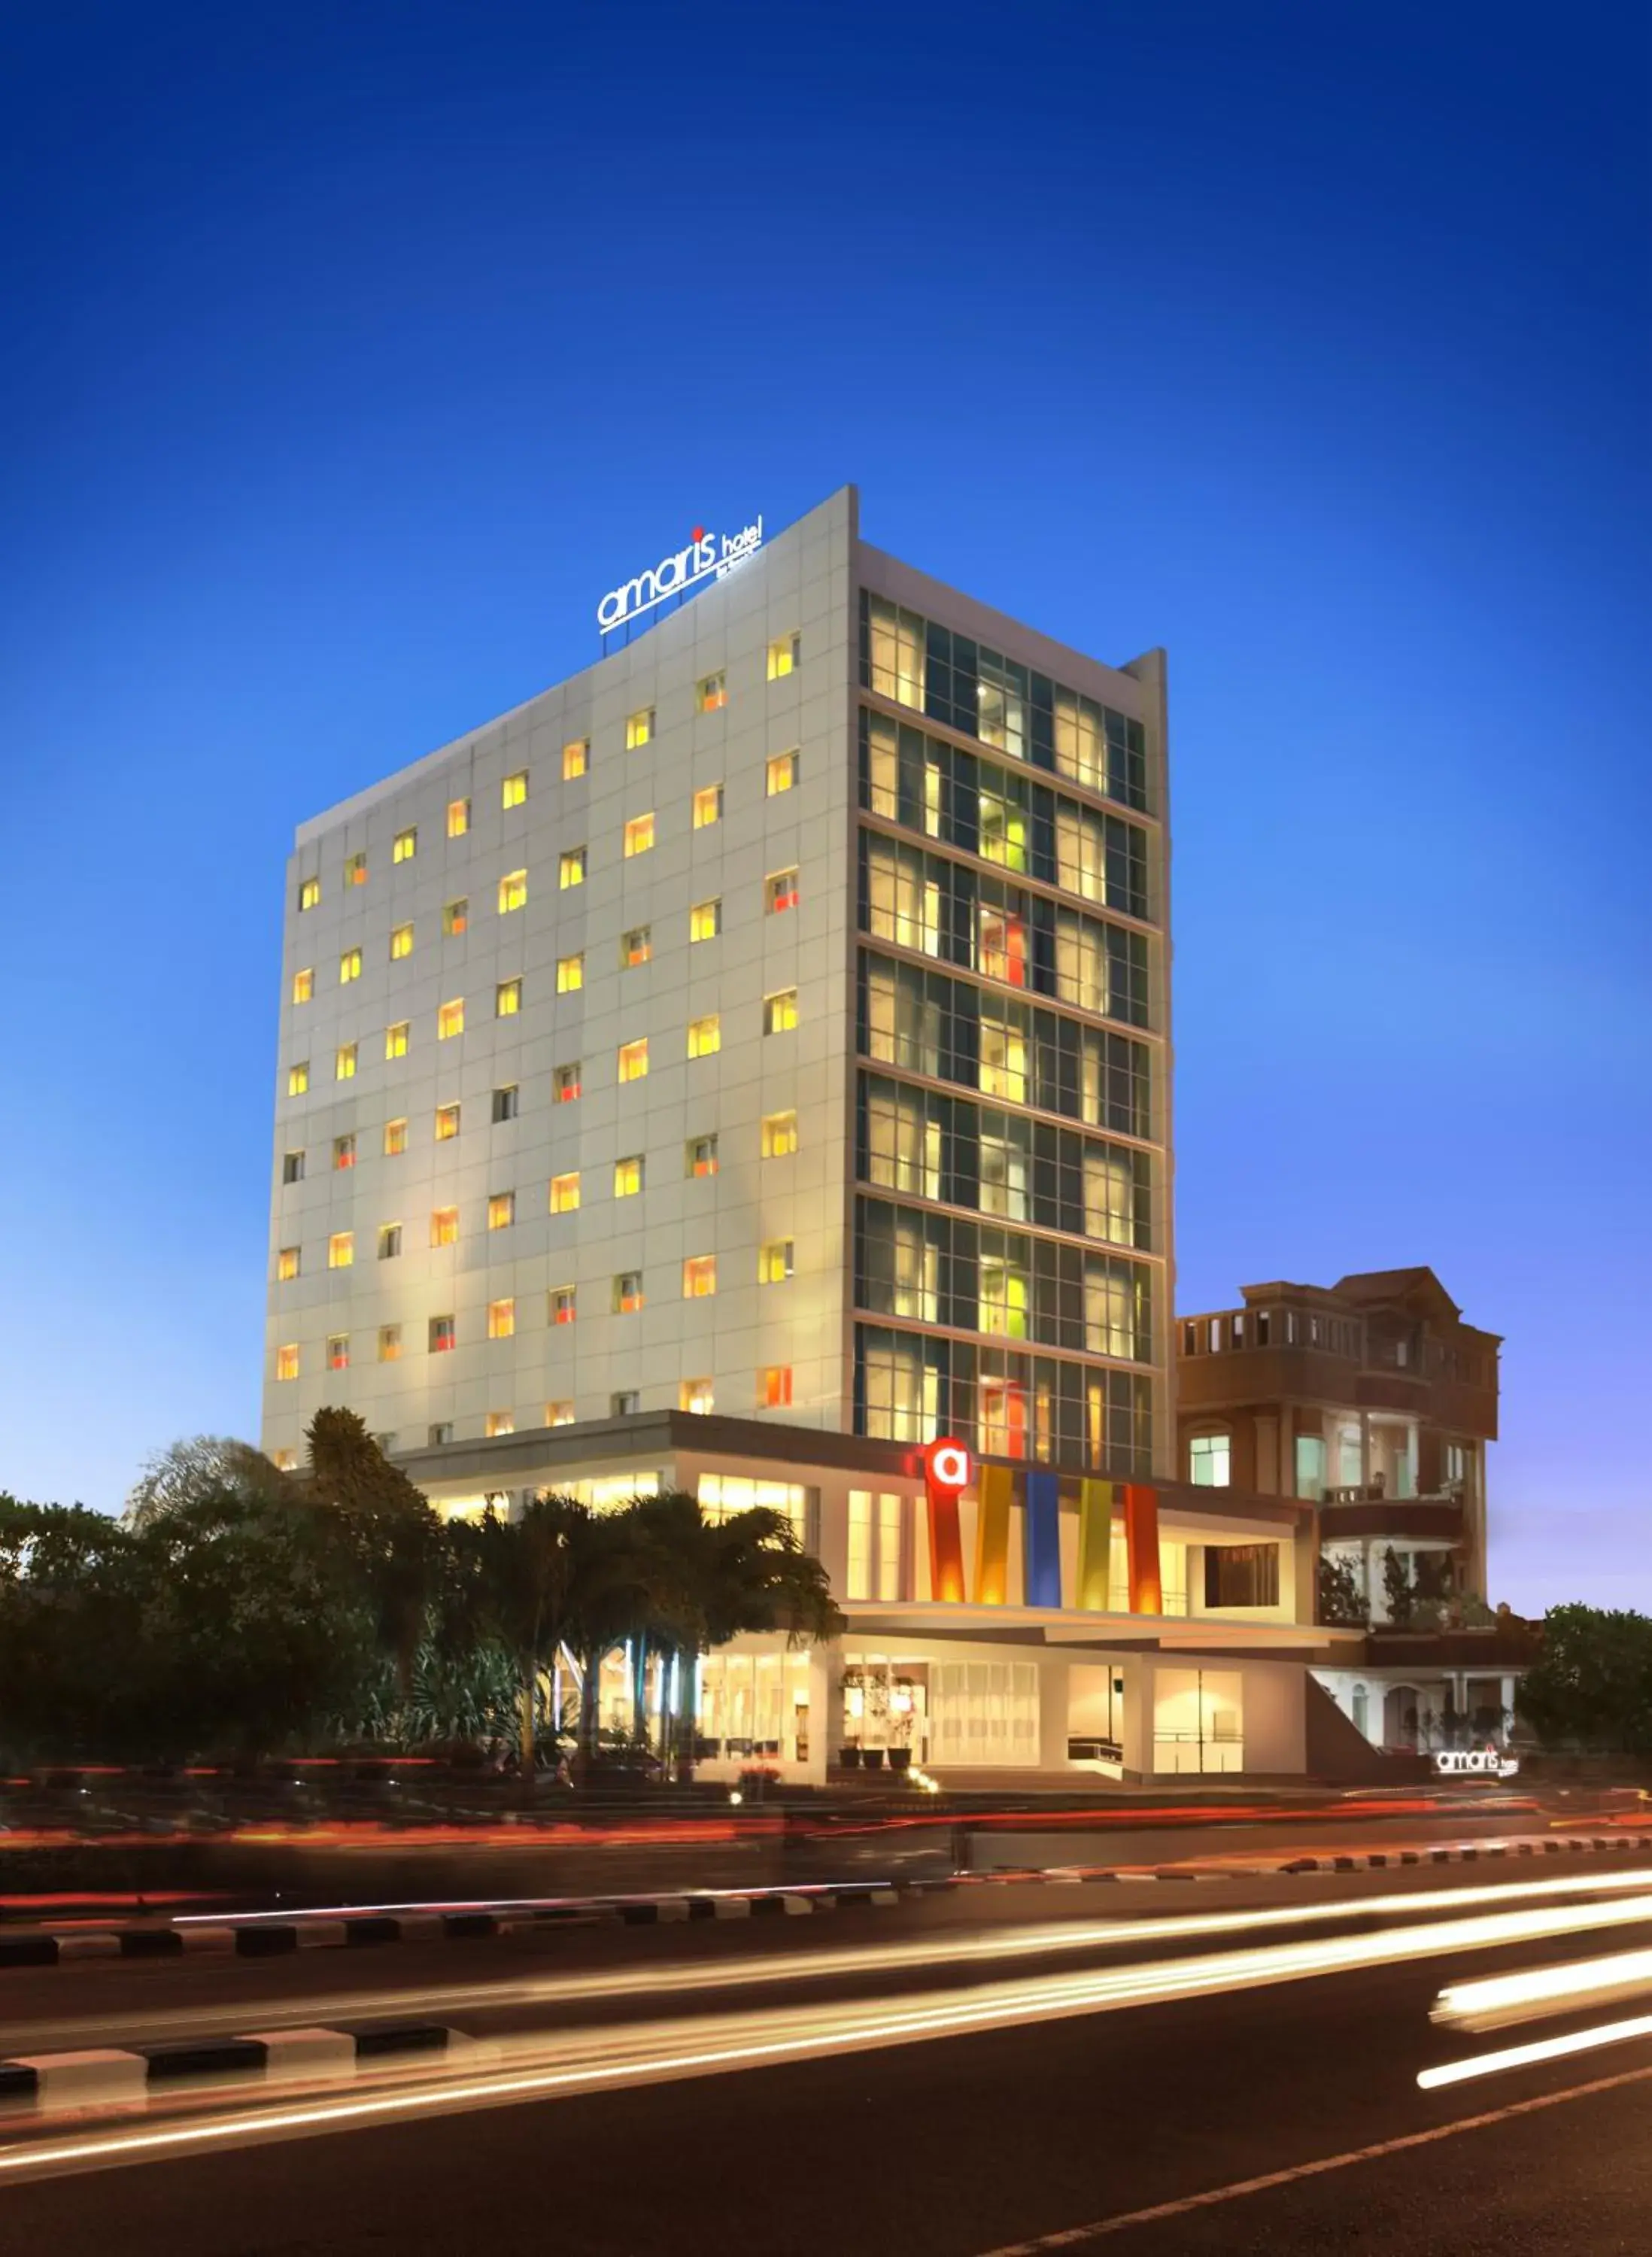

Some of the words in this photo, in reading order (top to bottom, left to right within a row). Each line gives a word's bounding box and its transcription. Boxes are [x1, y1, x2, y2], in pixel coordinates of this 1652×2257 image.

[597, 527, 715, 626] amaris
[722, 515, 762, 557] hotel
[933, 1447, 967, 1485] a
[1438, 1745, 1498, 1769] amaris
